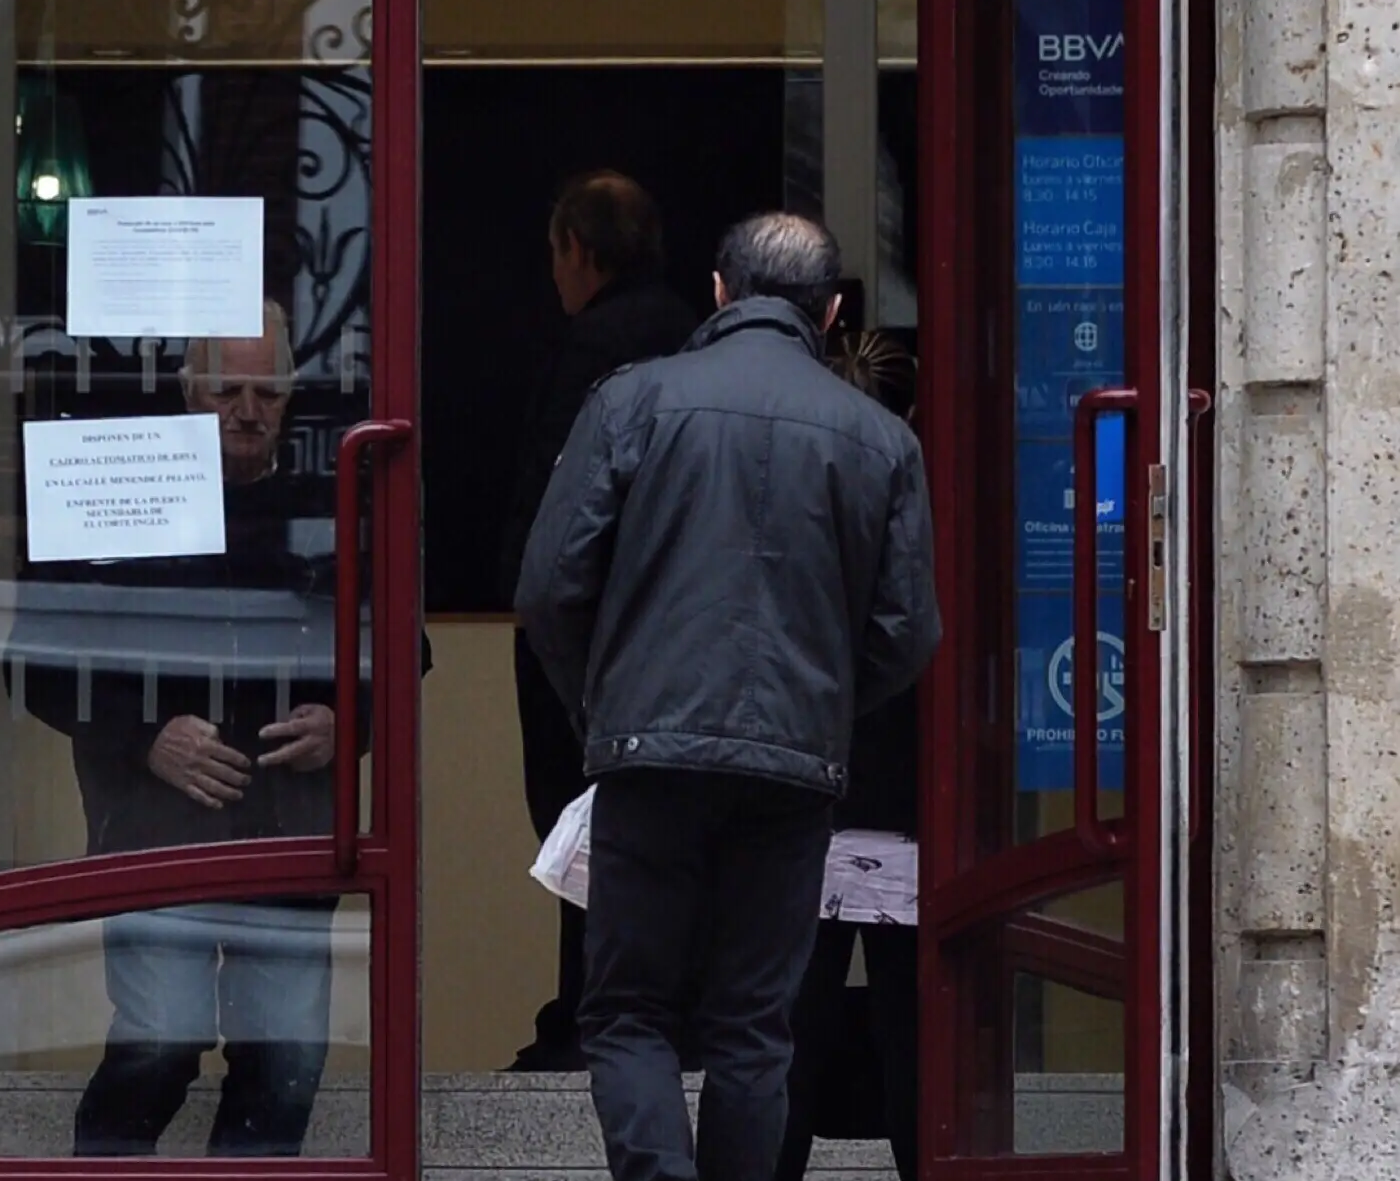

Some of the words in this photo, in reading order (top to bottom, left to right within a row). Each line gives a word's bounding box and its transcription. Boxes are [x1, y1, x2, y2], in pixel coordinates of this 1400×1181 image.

[1039, 70, 1091, 82] Creando
[1039, 84, 1124, 97] Oportunidade
[1023, 154, 1080, 169] Horario
[1083, 154, 1124, 169] Oficin
[1023, 221, 1081, 235] Horario
[1083, 220, 1117, 237] Caja
[132, 433, 145, 442] DE
[157, 454, 170, 462] DE
[119, 498, 132, 506] DE
[1025, 521, 1069, 533] Oficina
[1026, 728, 1107, 742] PROHIO
